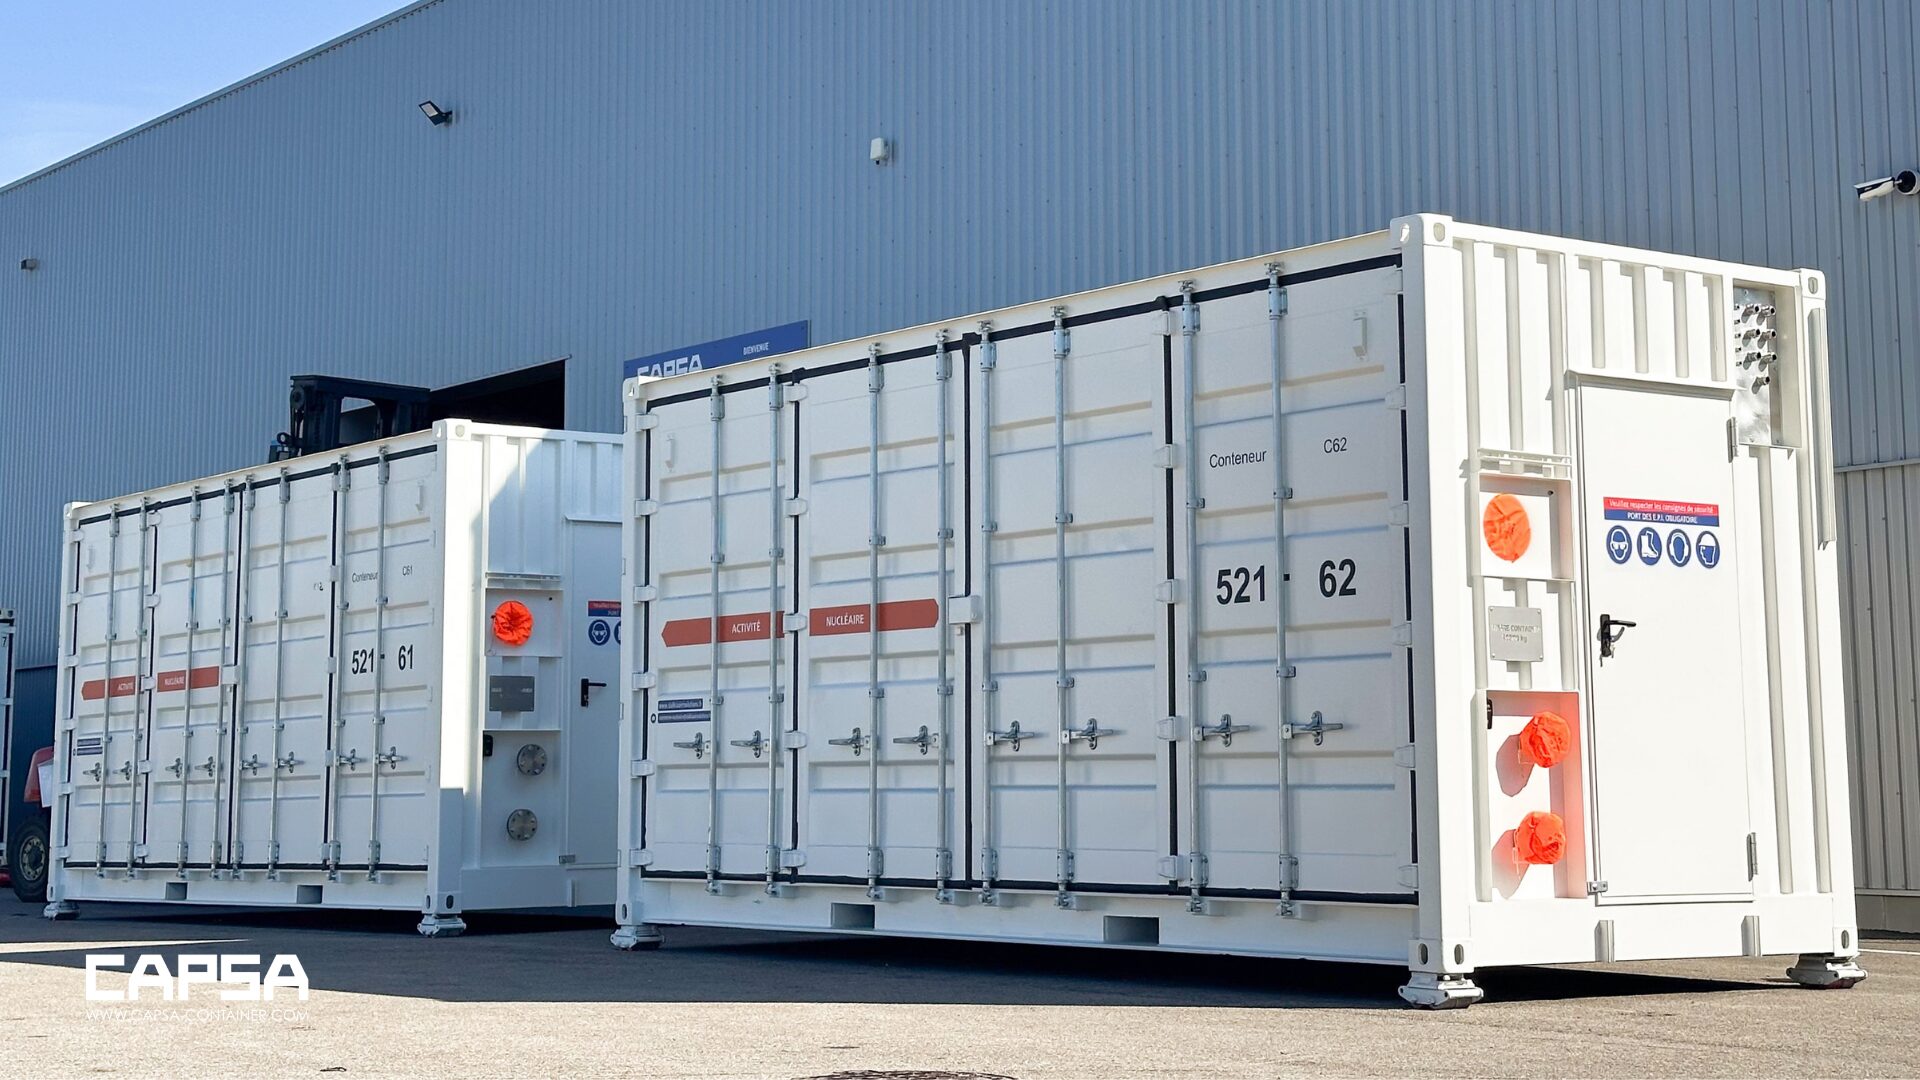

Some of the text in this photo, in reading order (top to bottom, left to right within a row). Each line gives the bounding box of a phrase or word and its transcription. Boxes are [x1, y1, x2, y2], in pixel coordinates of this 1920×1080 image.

[743, 342, 769, 356] BIENVENUE
[1209, 437, 1347, 468] Conteneur C62
[1630, 502, 1653, 510] respecter
[1662, 504, 1686, 513] consignes
[1627, 512, 1641, 520] PORT
[1642, 513, 1652, 521] DES
[1665, 514, 1698, 524] OBLIGATOIRE
[402, 565, 413, 576] C61
[1216, 565, 1265, 605] 521
[1319, 558, 1357, 598] 62
[731, 613, 865, 634] ACTIVITÉ NUCLÉAIRE
[351, 648, 375, 675] 521
[398, 644, 414, 671] 61
